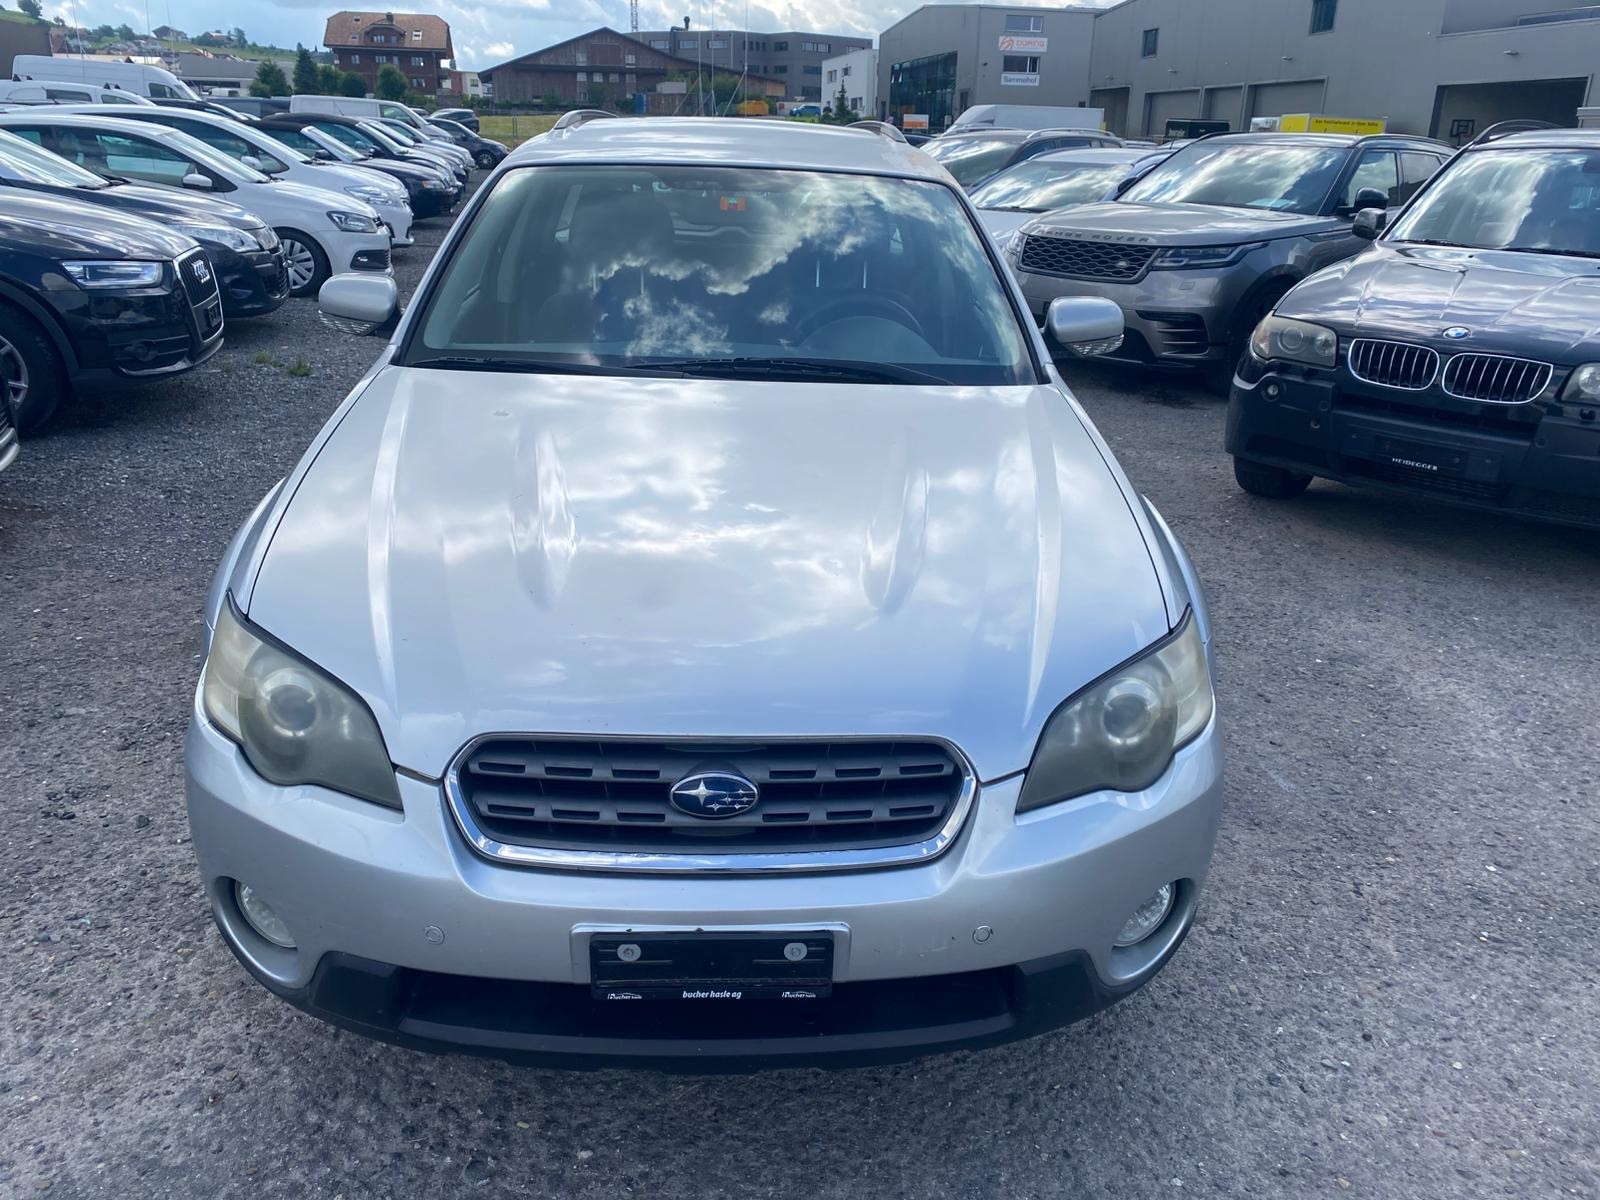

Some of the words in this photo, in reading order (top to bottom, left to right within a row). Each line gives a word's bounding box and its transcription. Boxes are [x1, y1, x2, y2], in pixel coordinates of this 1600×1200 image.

[1092, 234, 1150, 243] ROVER
[1392, 457, 1438, 471] HEIDEGGER
[682, 990, 709, 998] bucher
[710, 990, 731, 998] hasle
[731, 991, 742, 1000] ag
